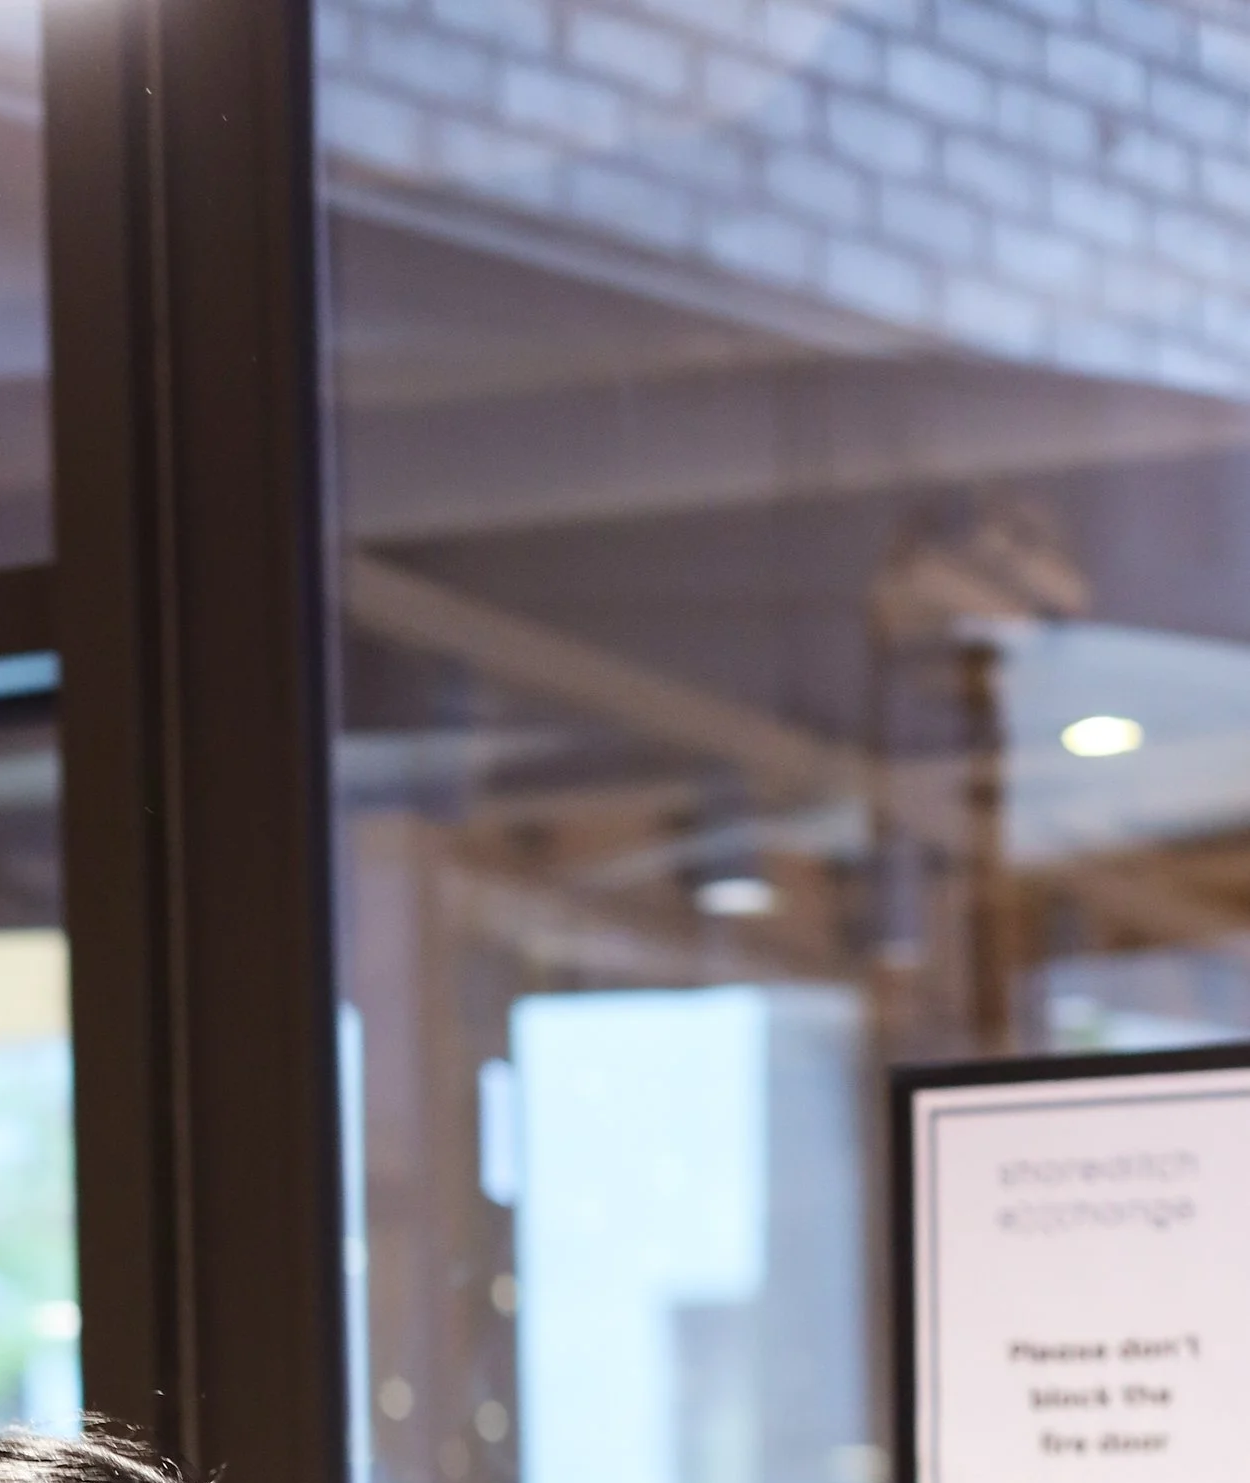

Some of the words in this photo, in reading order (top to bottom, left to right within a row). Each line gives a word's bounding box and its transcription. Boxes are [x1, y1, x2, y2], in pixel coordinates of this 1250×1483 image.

[1008, 1337, 1105, 1362] Please
[1118, 1333, 1200, 1361] don't
[1029, 1386, 1109, 1409] block
[1121, 1384, 1172, 1407] the
[1038, 1426, 1086, 1454] fire
[1097, 1430, 1171, 1454] door
